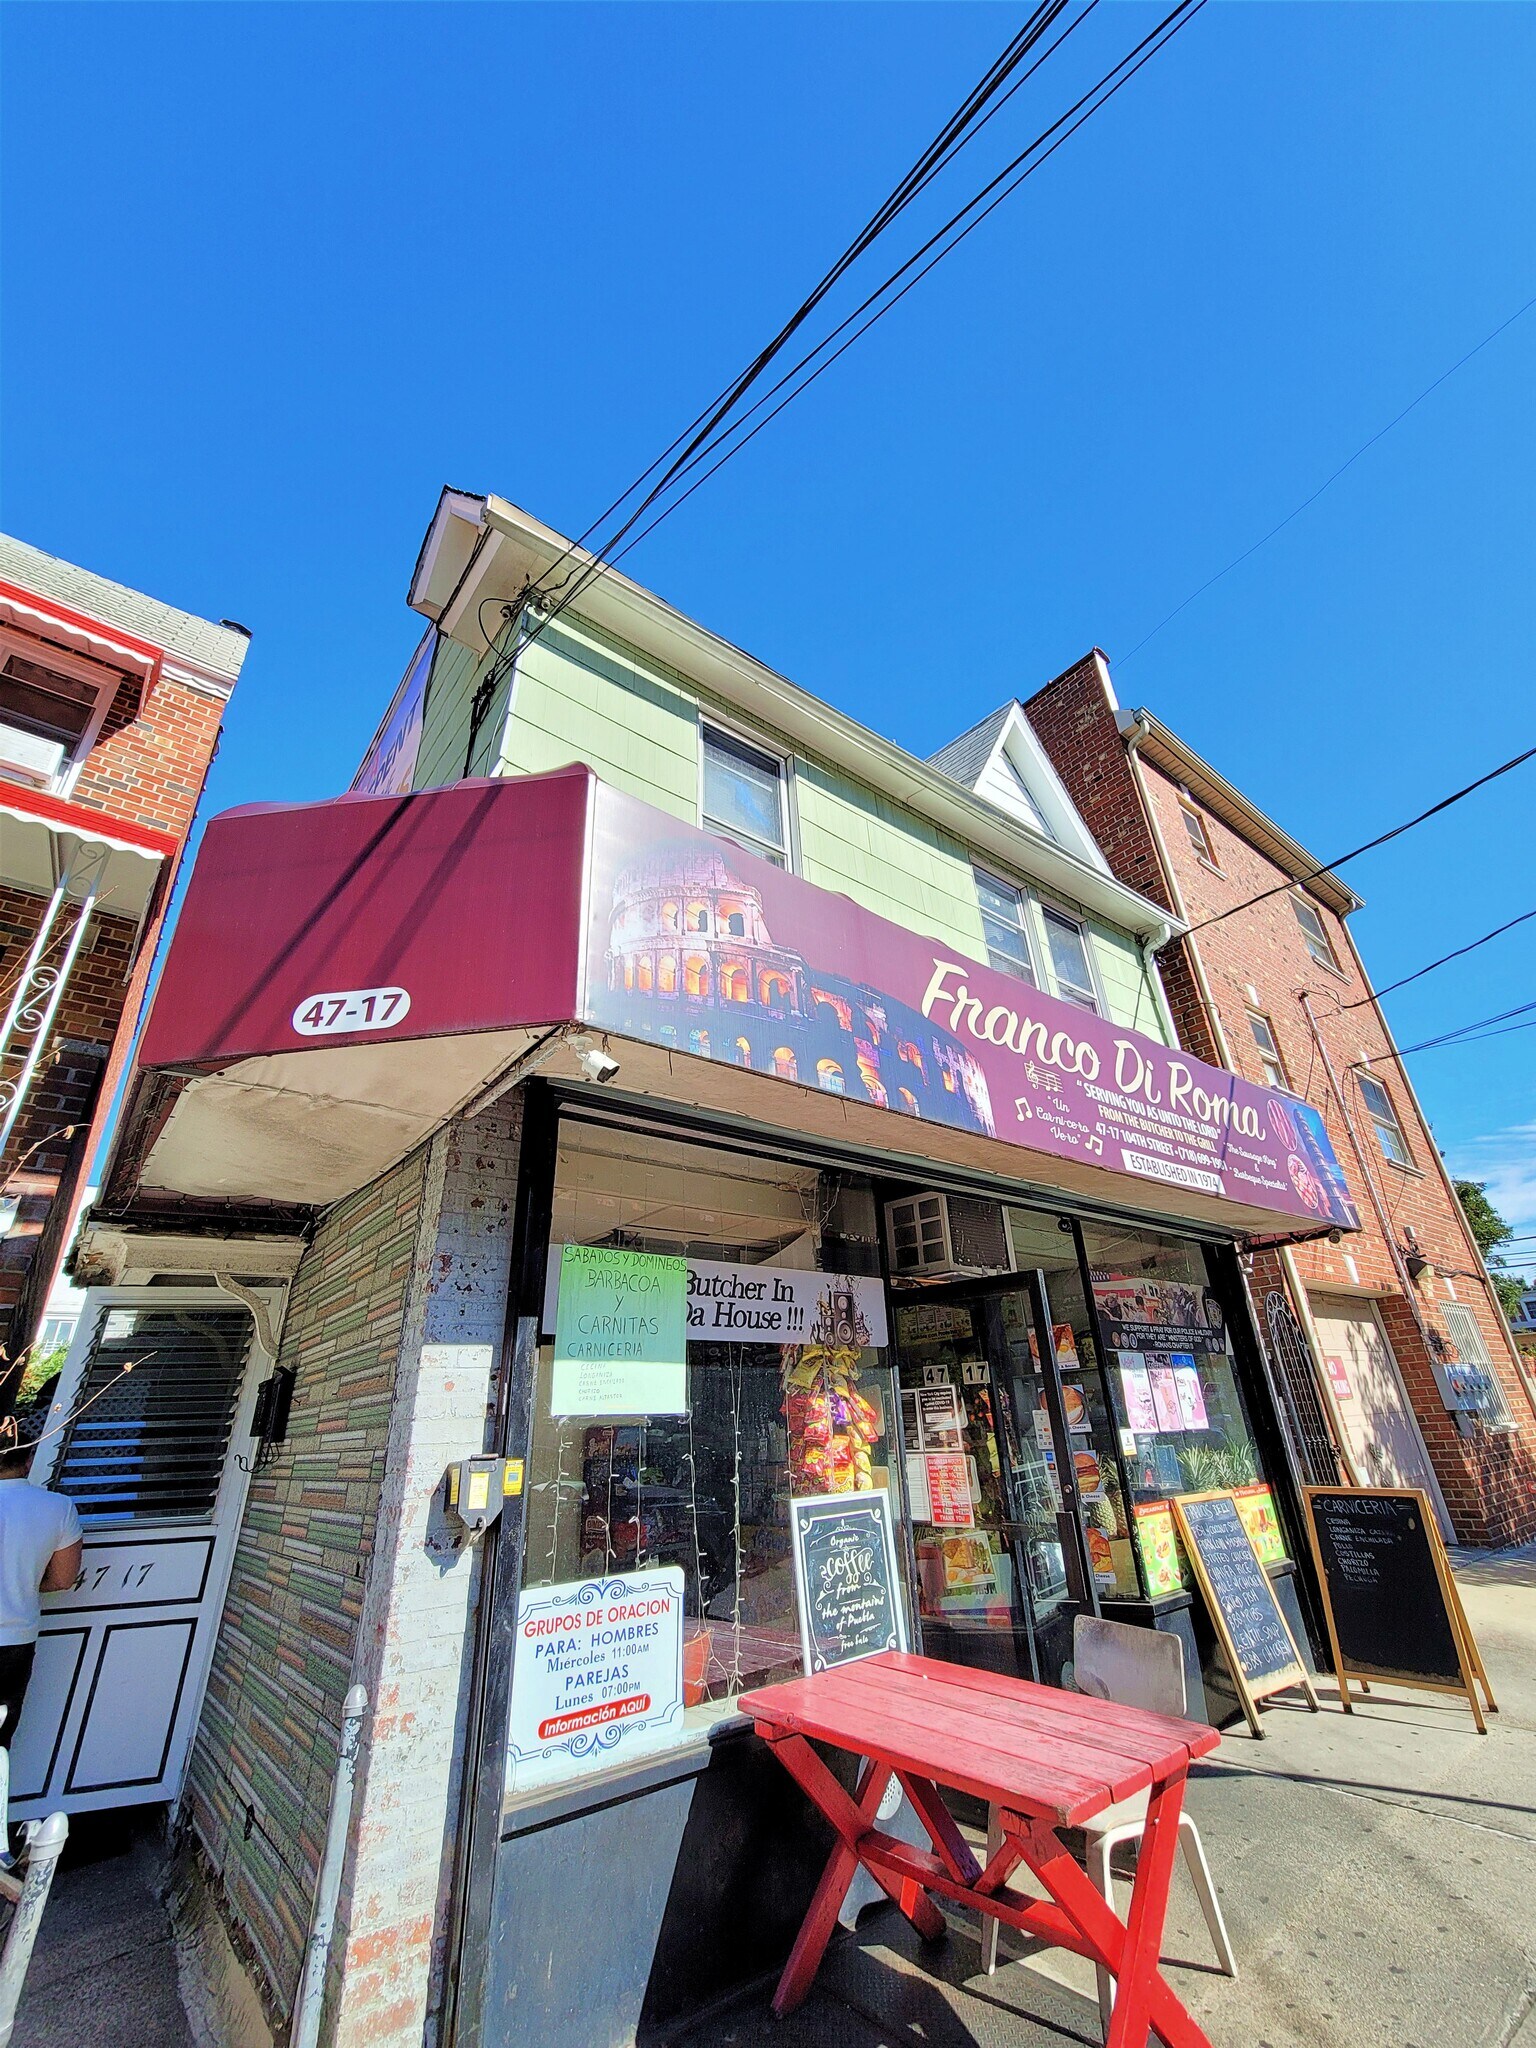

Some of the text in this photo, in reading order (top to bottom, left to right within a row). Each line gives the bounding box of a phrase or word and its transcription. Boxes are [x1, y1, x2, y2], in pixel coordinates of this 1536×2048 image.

[301, 993, 403, 1028] 47-17
[920, 958, 1266, 1142] Franco Di Roma
[1125, 1097, 1146, 1117] YOU
[1146, 1104, 1159, 1120] AS
[1158, 1109, 1182, 1128] UNTO
[1180, 1116, 1198, 1133] THE
[1098, 1104, 1218, 1152] FROM THE BUTCHER THE GRILL
[1095, 1122, 1119, 1140] 47-17
[1120, 1130, 1147, 1148] 104TH
[1146, 1137, 1174, 1156] STREET
[1177, 1146, 1197, 1164] (718)
[1130, 1154, 1219, 1189] ESTABLISHED IN 1974
[564, 1246, 620, 1264] SABADOS
[631, 1253, 687, 1272] DOMINGOS
[585, 1269, 661, 1294] BARBACOA
[771, 1277, 795, 1303] In
[614, 1294, 625, 1312] Y
[712, 1301, 782, 1330] House
[578, 1314, 659, 1335] CARNITAS
[1129, 1324, 1150, 1332] SUPPORT
[1136, 1332, 1146, 1340] FOR
[1157, 1333, 1166, 1341] ARE
[567, 1342, 643, 1358] CARNICERIA
[926, 1367, 946, 1384] 47
[965, 1365, 986, 1381] 17
[1323, 1499, 1398, 1516] CARNICERIA
[830, 1534, 859, 1548] Organic
[1332, 1541, 1353, 1550] POLLO
[822, 1548, 874, 1584] coffee
[1335, 1550, 1375, 1560] COSTILLAS
[1337, 1557, 1369, 1567] CHORIZO
[121, 1562, 155, 1588] 17
[1340, 1564, 1380, 1577] PALOMILLA
[836, 1582, 862, 1600] from
[524, 1598, 671, 1638] GRUPOS DE ORACION
[822, 1603, 839, 1620] the
[836, 1609, 875, 1632] of Puebla
[535, 1622, 659, 1658] PARA: HOMBRES
[1261, 1621, 1280, 1641] SOUP
[546, 1643, 650, 1673] Miércoles 11:00AM
[565, 1664, 629, 1691] PAREJAS
[555, 1681, 641, 1711] Lunes 07:00PM
[544, 1694, 647, 1737] Información AQUÍ
